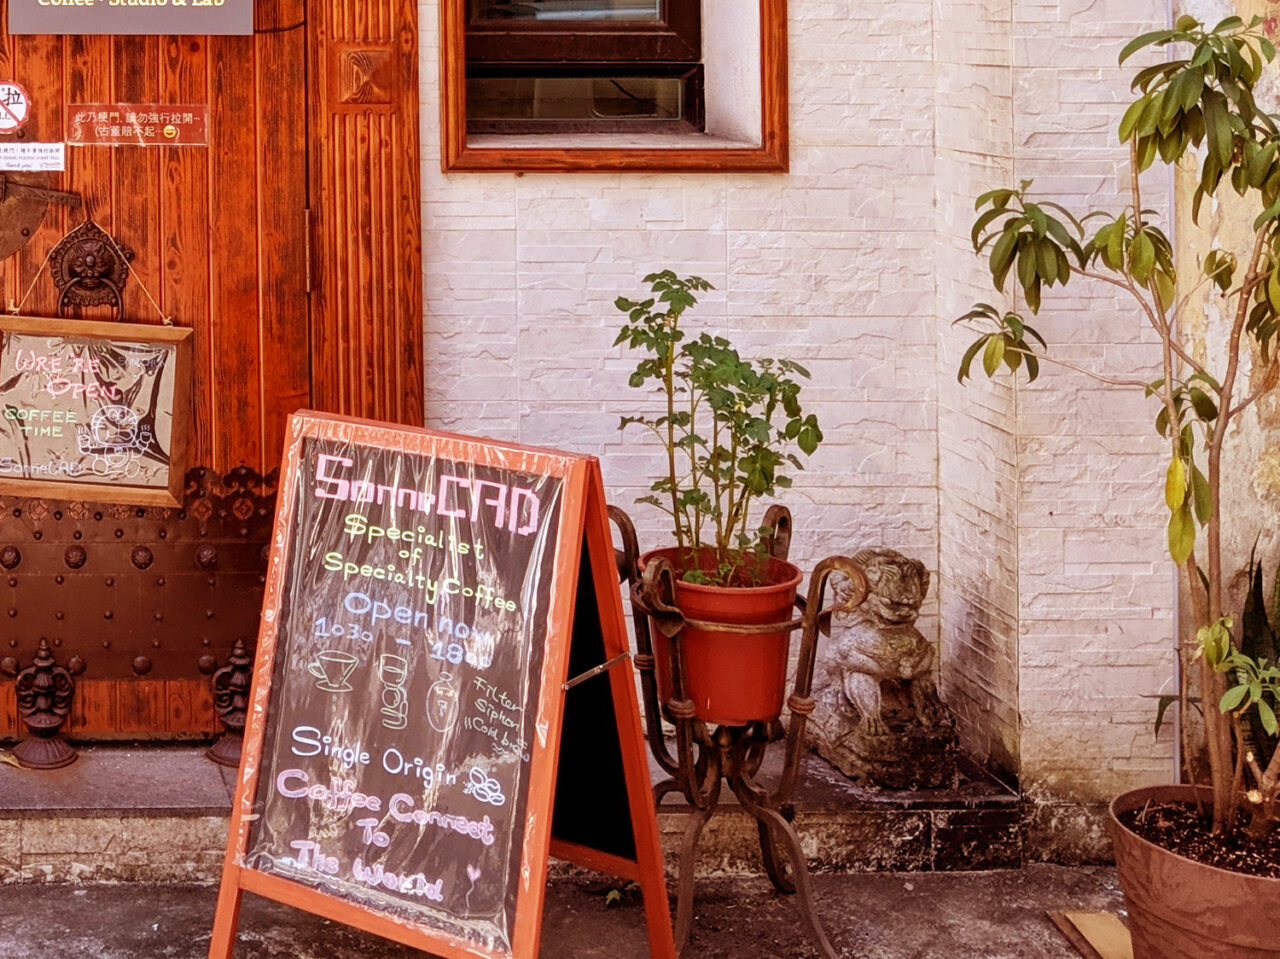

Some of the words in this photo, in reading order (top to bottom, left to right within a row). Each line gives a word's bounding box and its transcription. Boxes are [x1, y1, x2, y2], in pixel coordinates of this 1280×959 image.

[3, 87, 24, 107] 拉
[45, 378, 117, 400] OPEN
[4, 408, 78, 424] COFFEE
[19, 426, 65, 438] TIME
[344, 514, 484, 560] Specialist
[399, 548, 423, 566] of
[324, 552, 438, 604] Specialty
[443, 578, 516, 612] Coffee
[344, 592, 428, 628] Open
[315, 617, 373, 642] 1030
[473, 675, 524, 712] Filter
[472, 716, 498, 741] Cold
[291, 726, 371, 769] Single
[382, 748, 457, 789] Origin
[277, 768, 382, 811] Coffee
[389, 792, 494, 846] Connect
[356, 818, 391, 848] To
[290, 840, 339, 874] The
